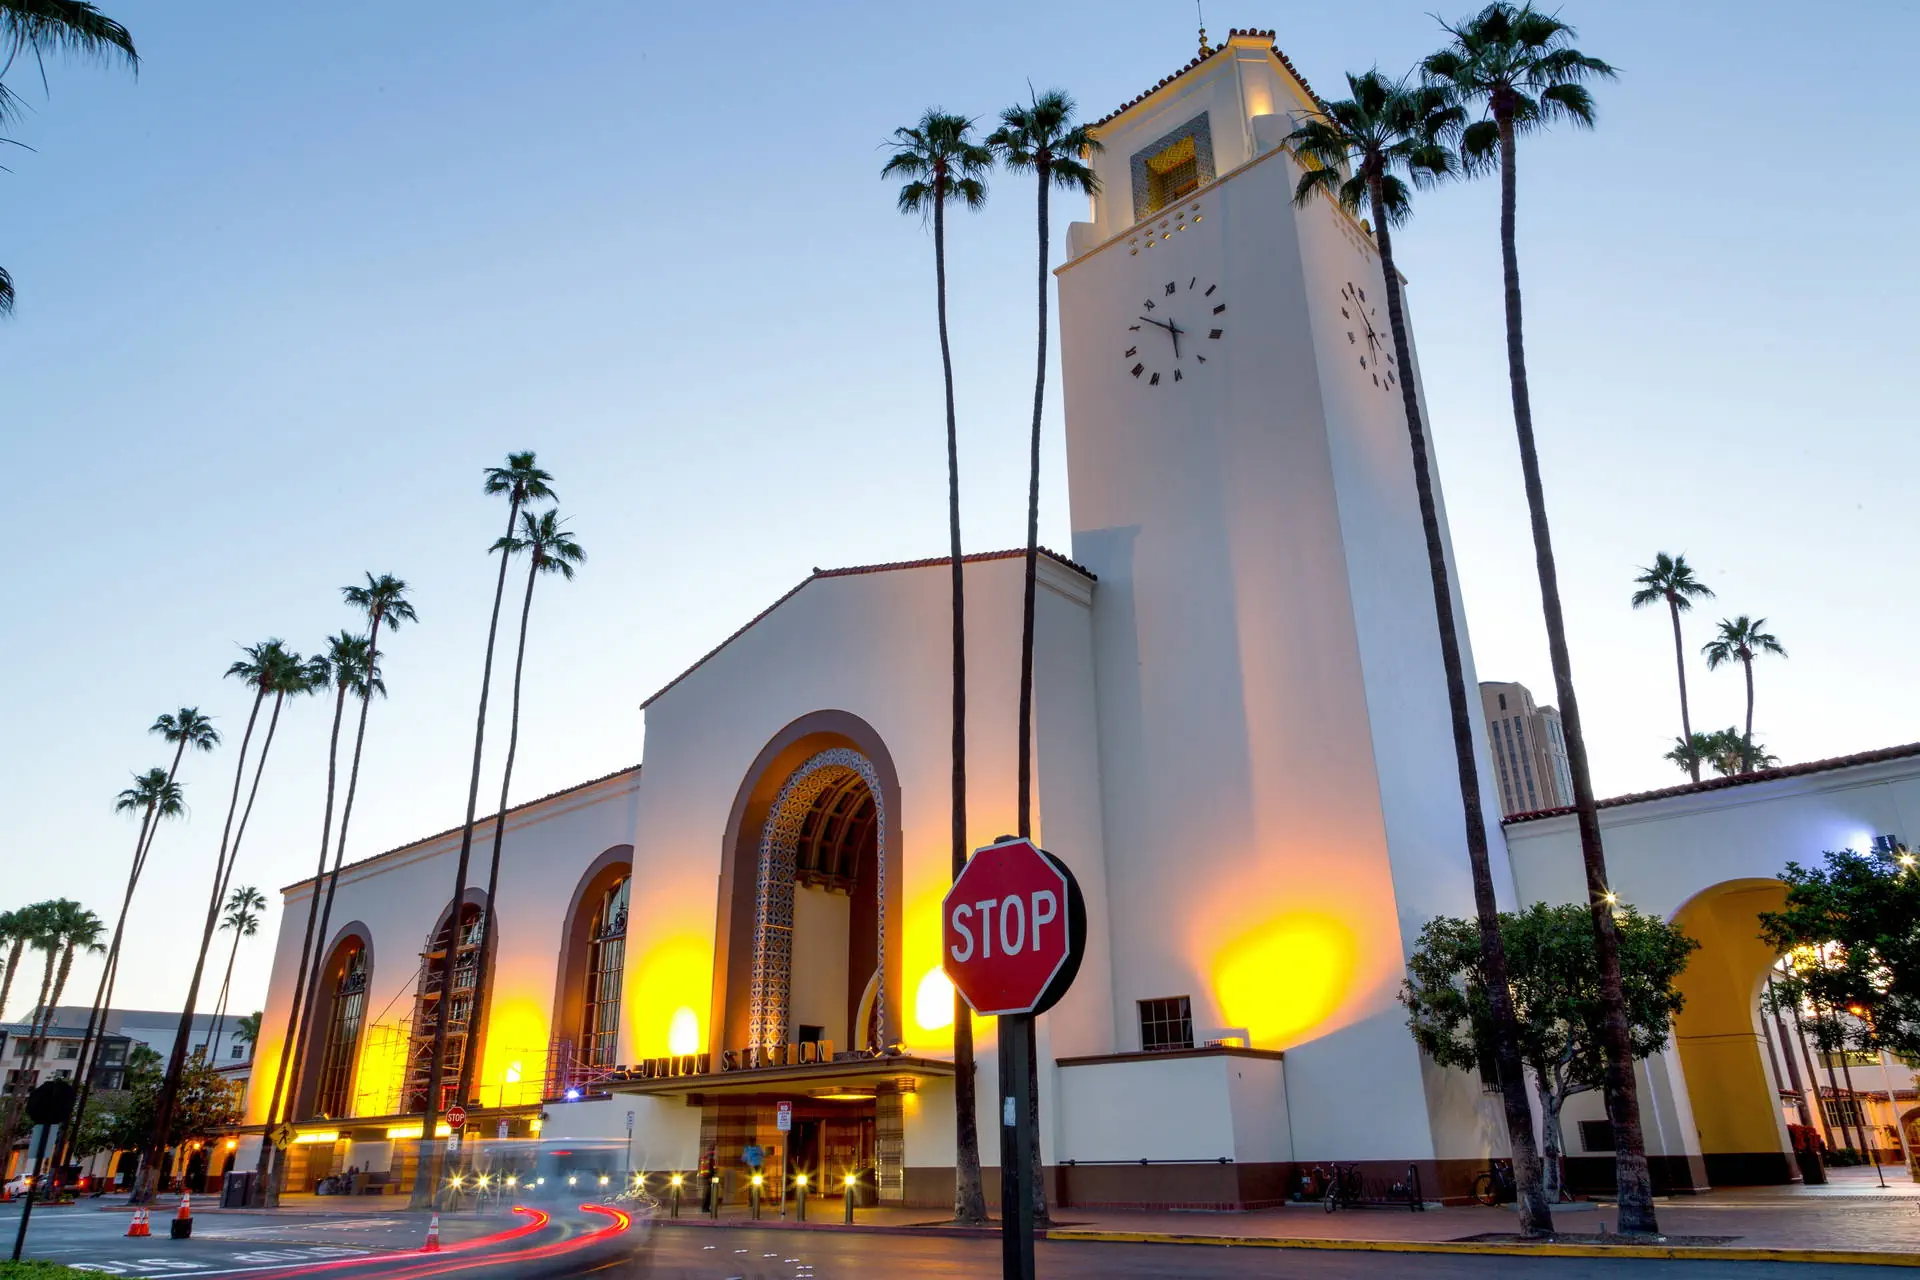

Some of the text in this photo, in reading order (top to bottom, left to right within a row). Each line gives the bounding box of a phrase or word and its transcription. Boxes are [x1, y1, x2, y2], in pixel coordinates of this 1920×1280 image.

[951, 889, 1057, 963] STOP
[641, 1039, 829, 1079] UNION STATION
[447, 1113, 465, 1122] STOP
